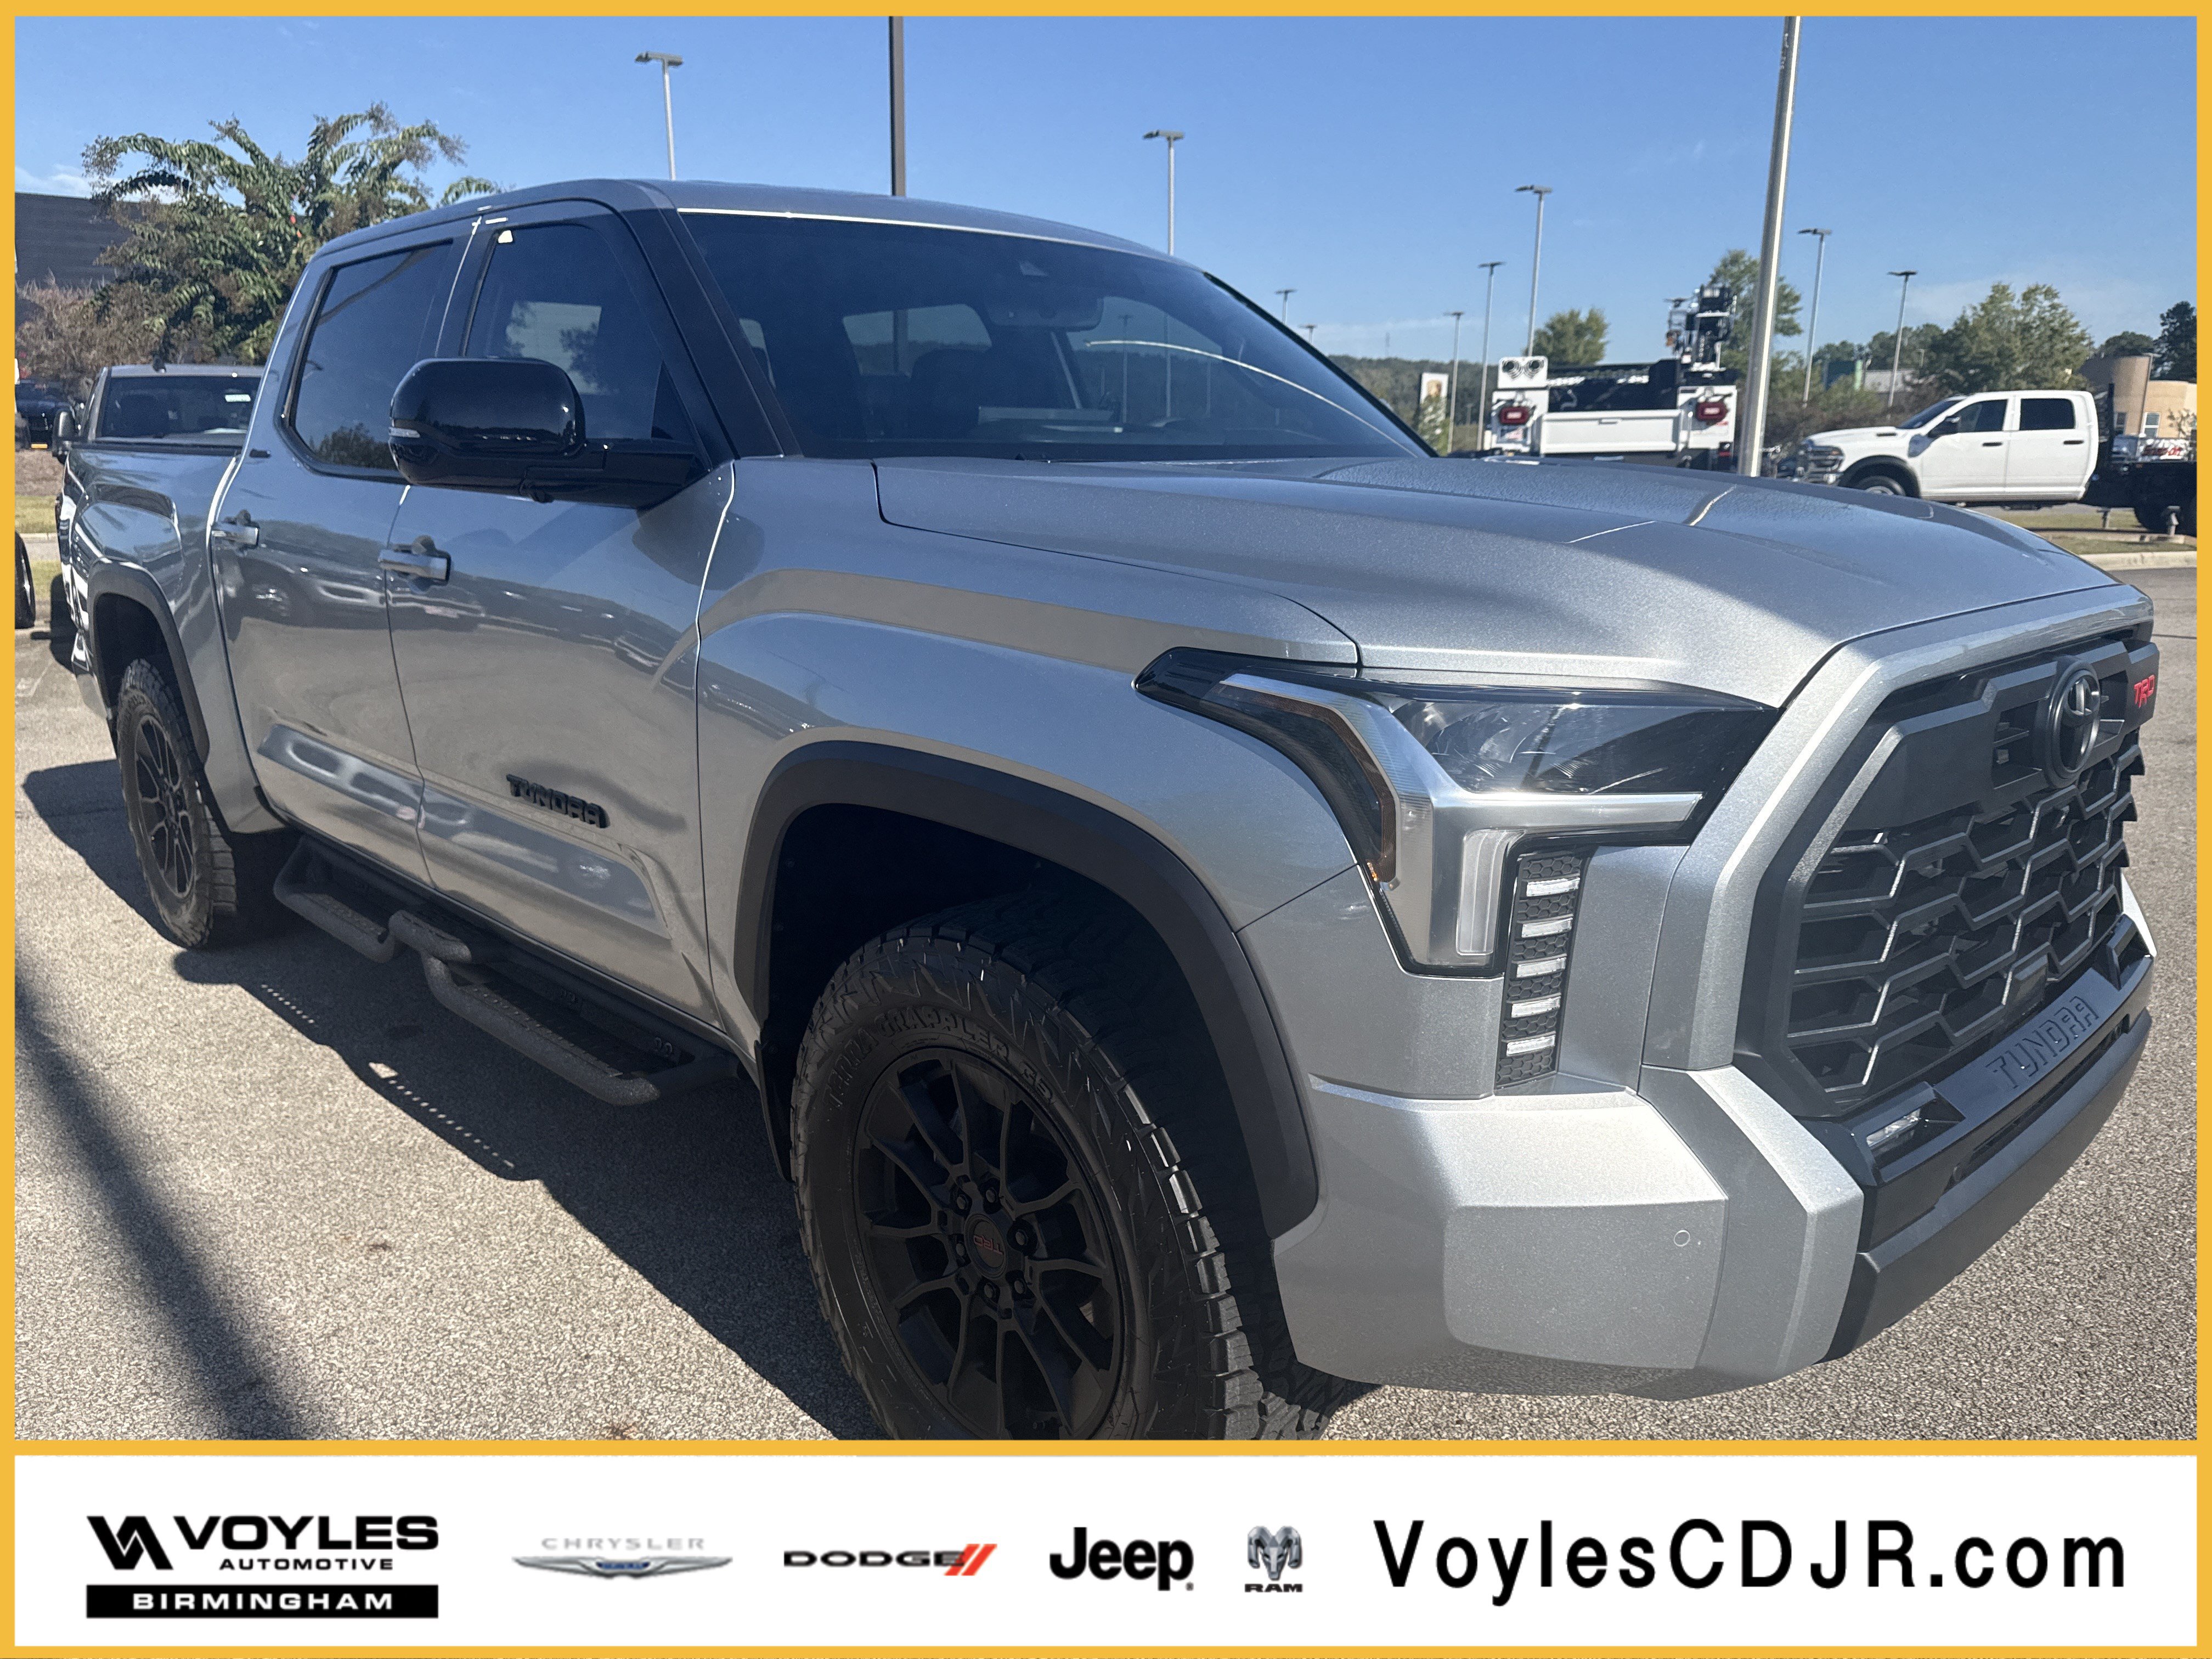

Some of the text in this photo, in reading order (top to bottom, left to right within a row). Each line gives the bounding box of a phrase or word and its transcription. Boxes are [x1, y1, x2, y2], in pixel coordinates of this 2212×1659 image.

[2133, 674, 2155, 708] TRD
[505, 773, 611, 829] TUNDRA
[873, 1005, 1013, 1063] GRAPPLER
[1985, 995, 2100, 1090] TUNDRA
[973, 1234, 1004, 1255] TRD
